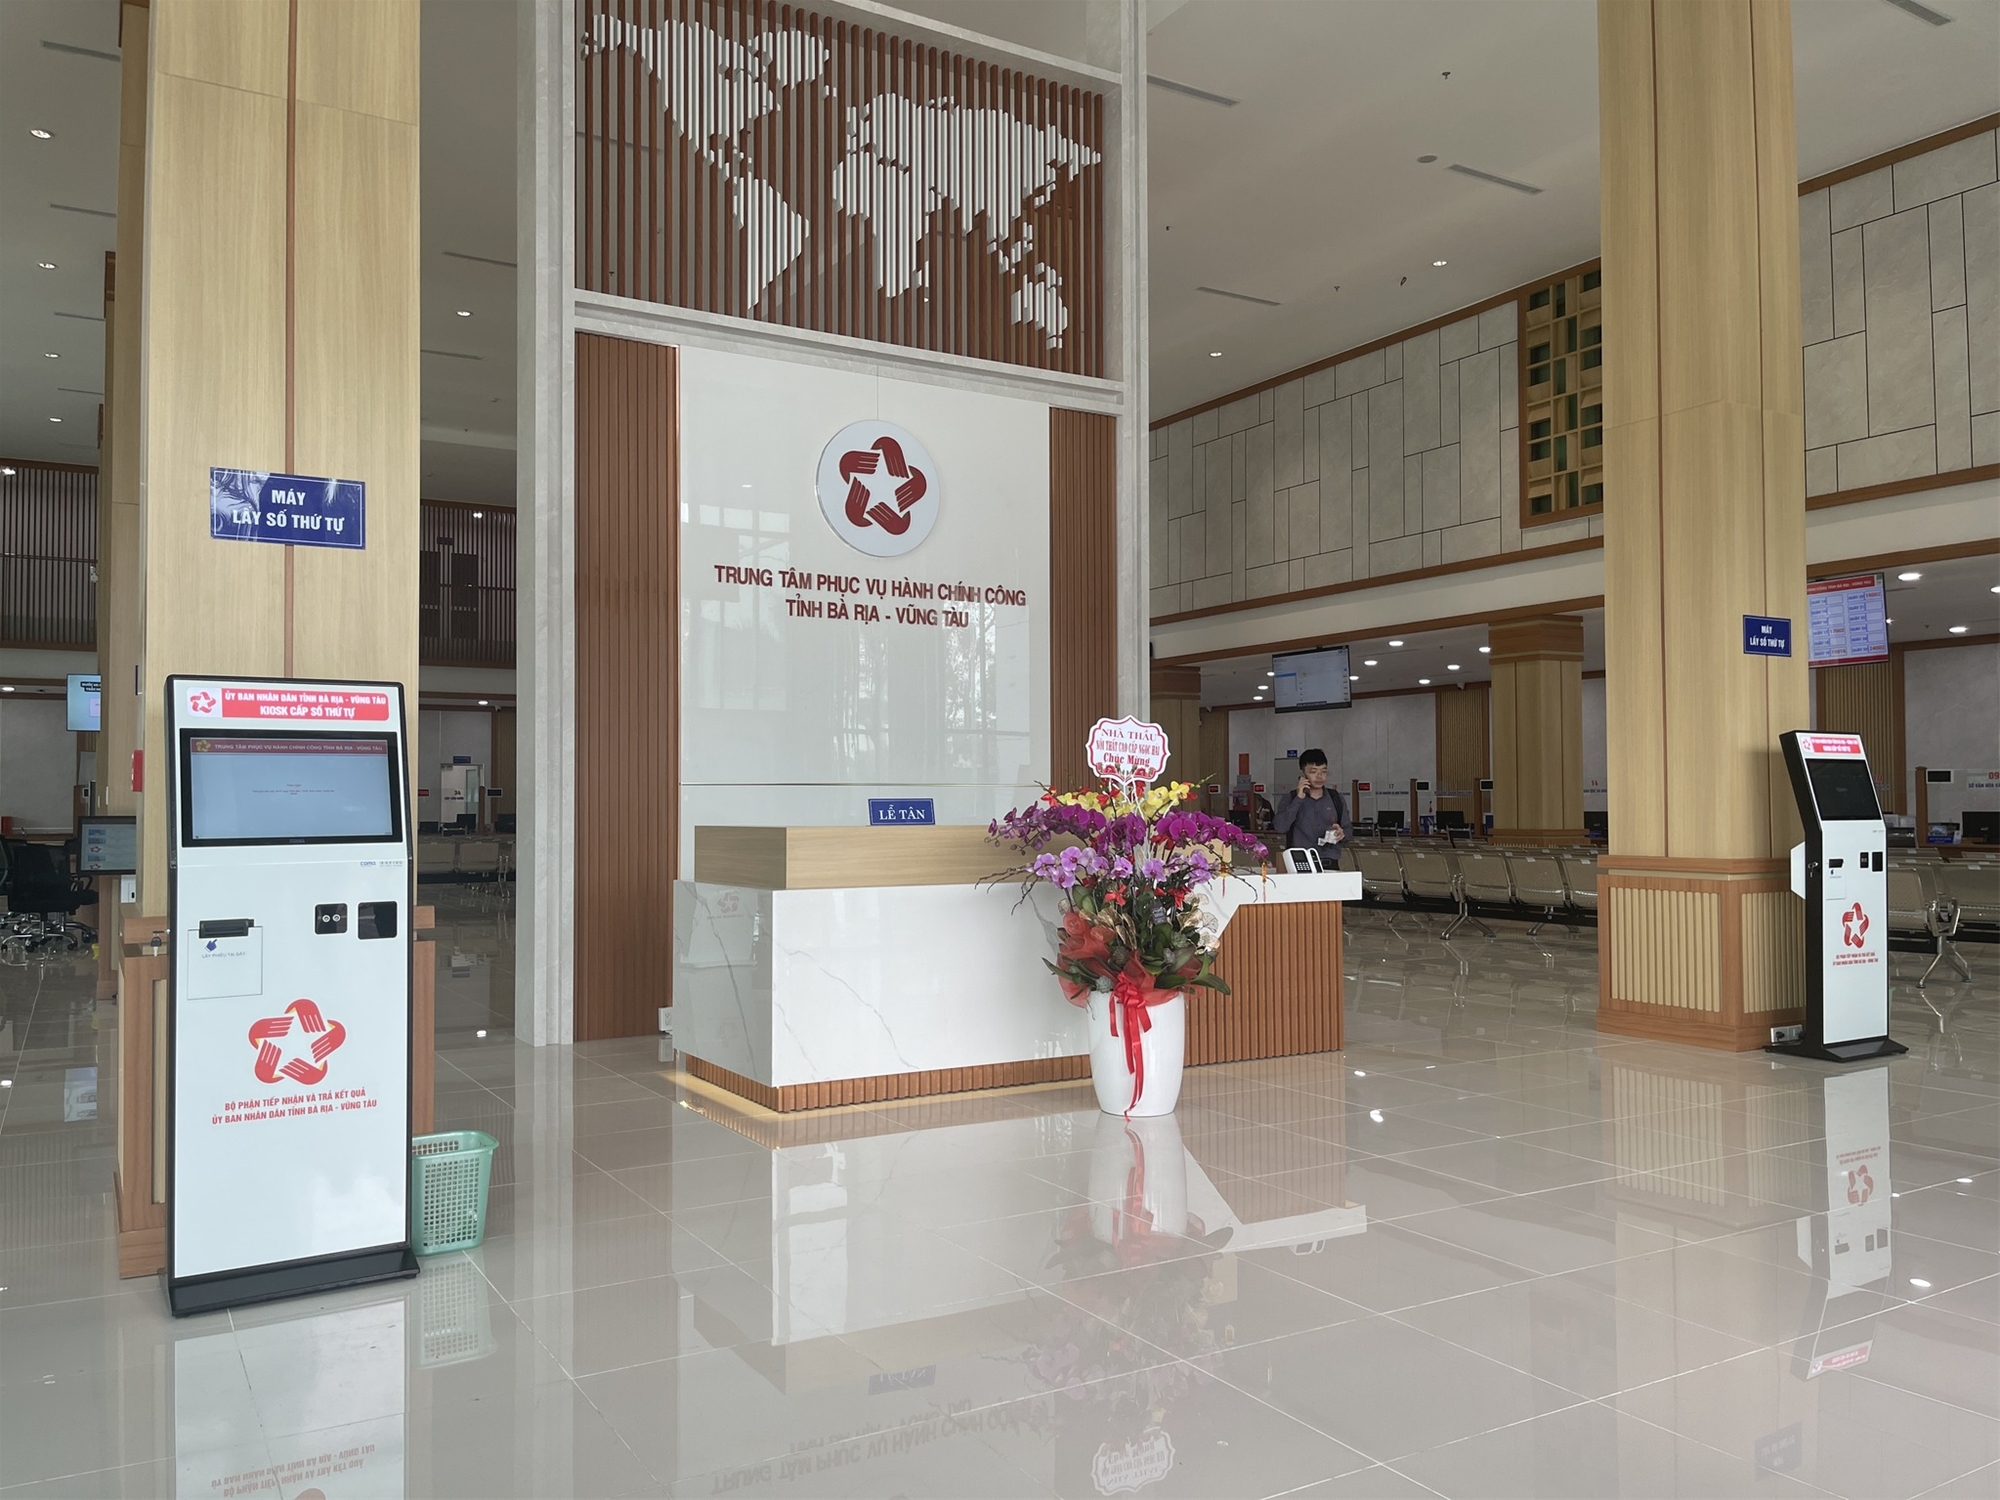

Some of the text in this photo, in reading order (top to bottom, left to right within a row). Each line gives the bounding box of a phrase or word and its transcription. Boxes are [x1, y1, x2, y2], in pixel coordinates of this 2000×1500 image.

[272, 489, 306, 505] MÁY
[266, 509, 286, 527] SỐ
[292, 514, 322, 530] THỨ
[325, 517, 345, 534] TỰ
[714, 565, 1026, 606] TRUNG TÂM PHỤC VỤ HÀNH CHÍNH CÔNG
[786, 593, 822, 618] TỈNH
[827, 599, 849, 620] BÀ
[854, 604, 880, 622] RỊA
[896, 604, 937, 626] VŨNG
[942, 610, 968, 628] TÀU
[1761, 625, 1772, 634] MÁY
[1750, 635, 1785, 649] LẤY SỐ THỨ TỰ
[225, 690, 235, 700] ỦY
[238, 693, 254, 701] BAN
[257, 692, 279, 701] NHÂN
[281, 693, 297, 702] DÂN
[299, 692, 316, 702] TỈNH
[318, 694, 329, 703] BÀ
[331, 696, 344, 704] RỊA
[350, 695, 370, 704] VŨNG
[372, 696, 386, 705] TÀU
[260, 704, 355, 719] KIOSK CẤP SỐ THỨ TỰ
[1102, 728, 1156, 741] NHÀ THẦU
[1104, 752, 1150, 767] Chúc Mừng
[879, 804, 925, 820] LỄ TÂN
[225, 1087, 366, 1112] BỘ PHẬN TIẾP NHẬN VÀ TRẢ KẾT QUẢ
[212, 1114, 222, 1124] ỦY
[225, 1114, 242, 1123] BAN
[244, 1111, 266, 1121] NHÂN
[269, 1108, 285, 1118] DÂN
[288, 1106, 305, 1116] TỈNH
[308, 1105, 318, 1114] BÀ
[320, 1104, 333, 1114] RỊA
[341, 1101, 361, 1110] VŨNG
[363, 1099, 377, 1108] TÀU
